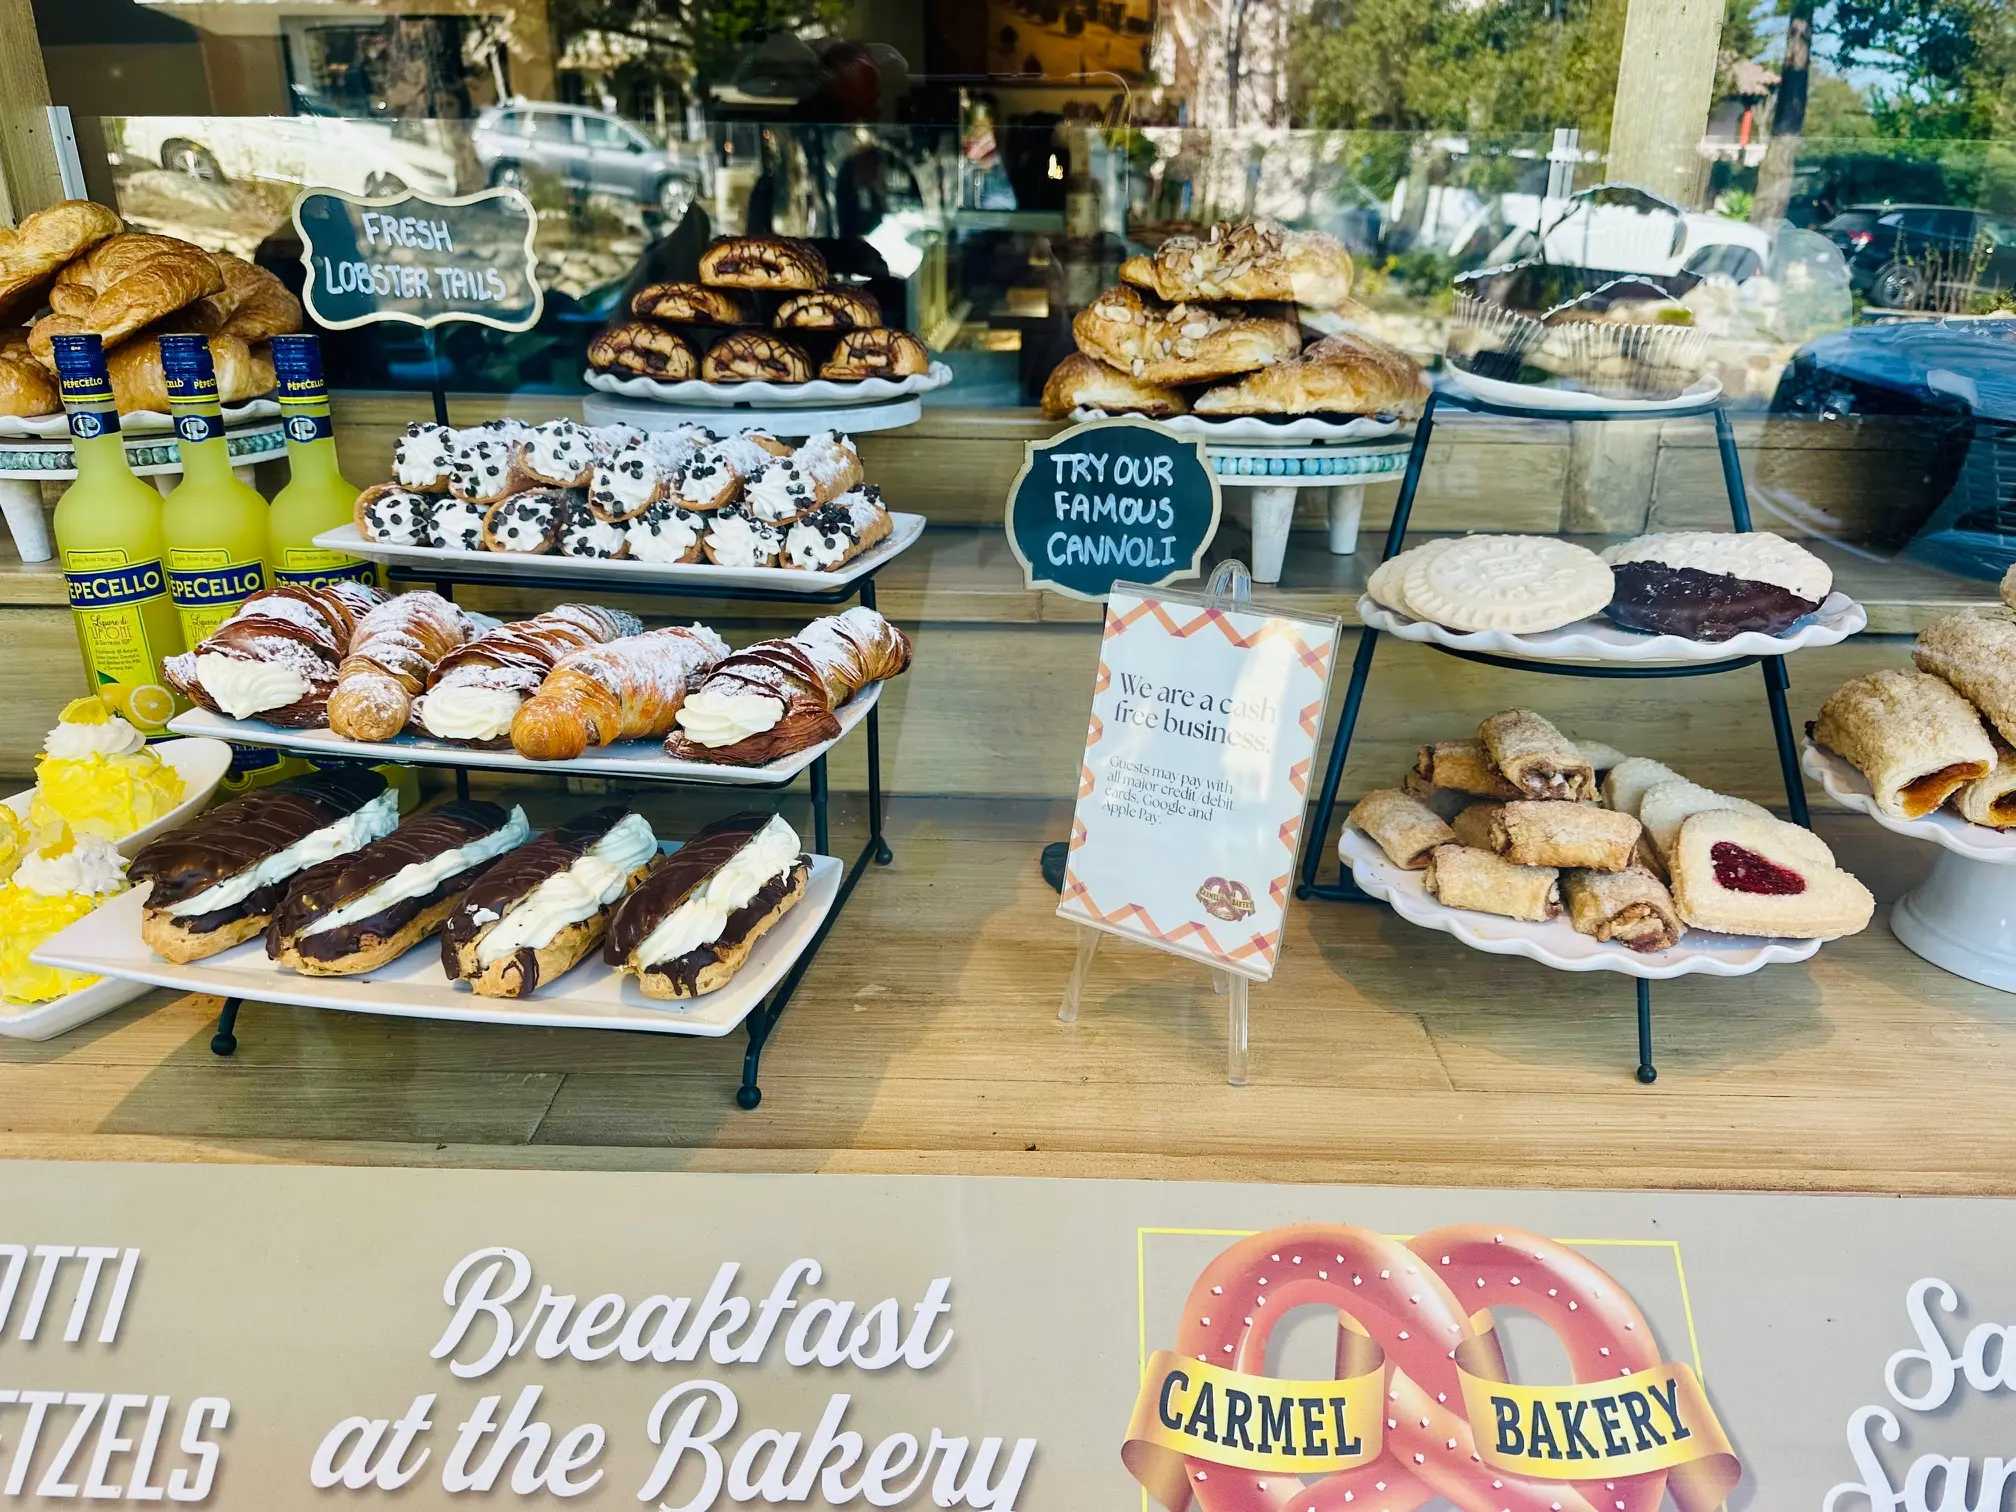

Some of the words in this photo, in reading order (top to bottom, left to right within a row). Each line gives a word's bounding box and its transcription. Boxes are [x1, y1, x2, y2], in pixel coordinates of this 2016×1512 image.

[362, 212, 453, 252] FRESH
[323, 257, 433, 300] LOBSTER
[434, 267, 506, 301] TAILS
[1050, 452, 1109, 484] TRY
[1113, 455, 1174, 487] OUR
[1054, 490, 1174, 529] FAMOUS
[1046, 531, 1176, 568] CANNOLI
[67, 571, 159, 599] ÈPECELLO
[170, 572, 260, 598] ÈPECELLO
[1120, 672, 1152, 698] We
[1157, 686, 1195, 707] are
[1199, 694, 1213, 712] a
[1219, 697, 1276, 724] cash
[1114, 700, 1158, 729] free
[1163, 708, 1271, 754] business.
[1107, 770, 1121, 784] all
[1123, 775, 1159, 793] major
[1109, 755, 1150, 775] Guests
[1152, 768, 1179, 784] may
[1181, 774, 1204, 790] pay
[1206, 778, 1233, 795] with
[1102, 799, 1137, 818] Apple
[1139, 807, 1162, 826] Pay.
[1143, 793, 1186, 816] Google
[1188, 808, 1213, 822] and
[429, 1246, 954, 1379] Breakfast
[1159, 1370, 1362, 1456] CARMEL
[1491, 1378, 1691, 1461] BAKERY
[310, 1393, 436, 1494] at
[441, 1385, 606, 1497] the
[637, 1379, 1038, 1512] Bakery
